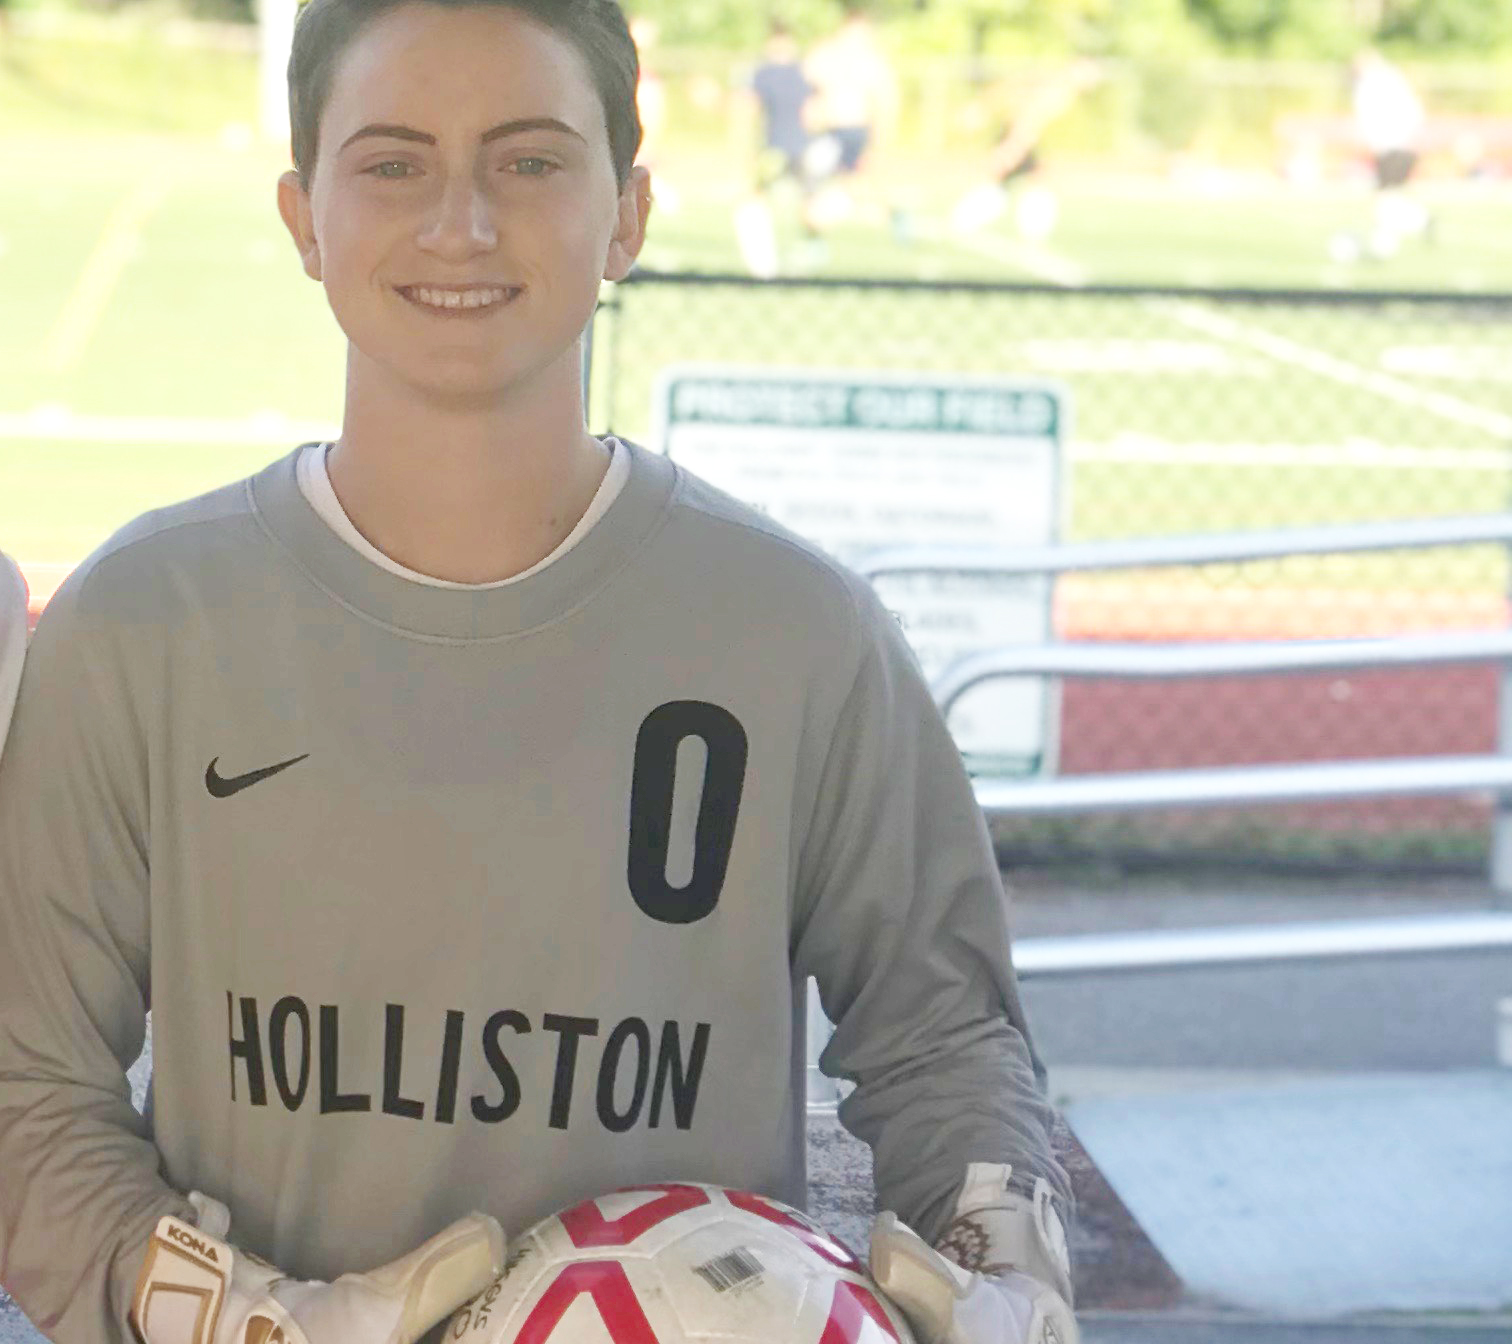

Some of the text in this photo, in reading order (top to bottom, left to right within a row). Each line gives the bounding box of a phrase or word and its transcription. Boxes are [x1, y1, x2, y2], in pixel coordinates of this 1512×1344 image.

[627, 700, 748, 924] 0
[226, 990, 711, 1133] HOLLISTON
[167, 1224, 219, 1264] KONA
